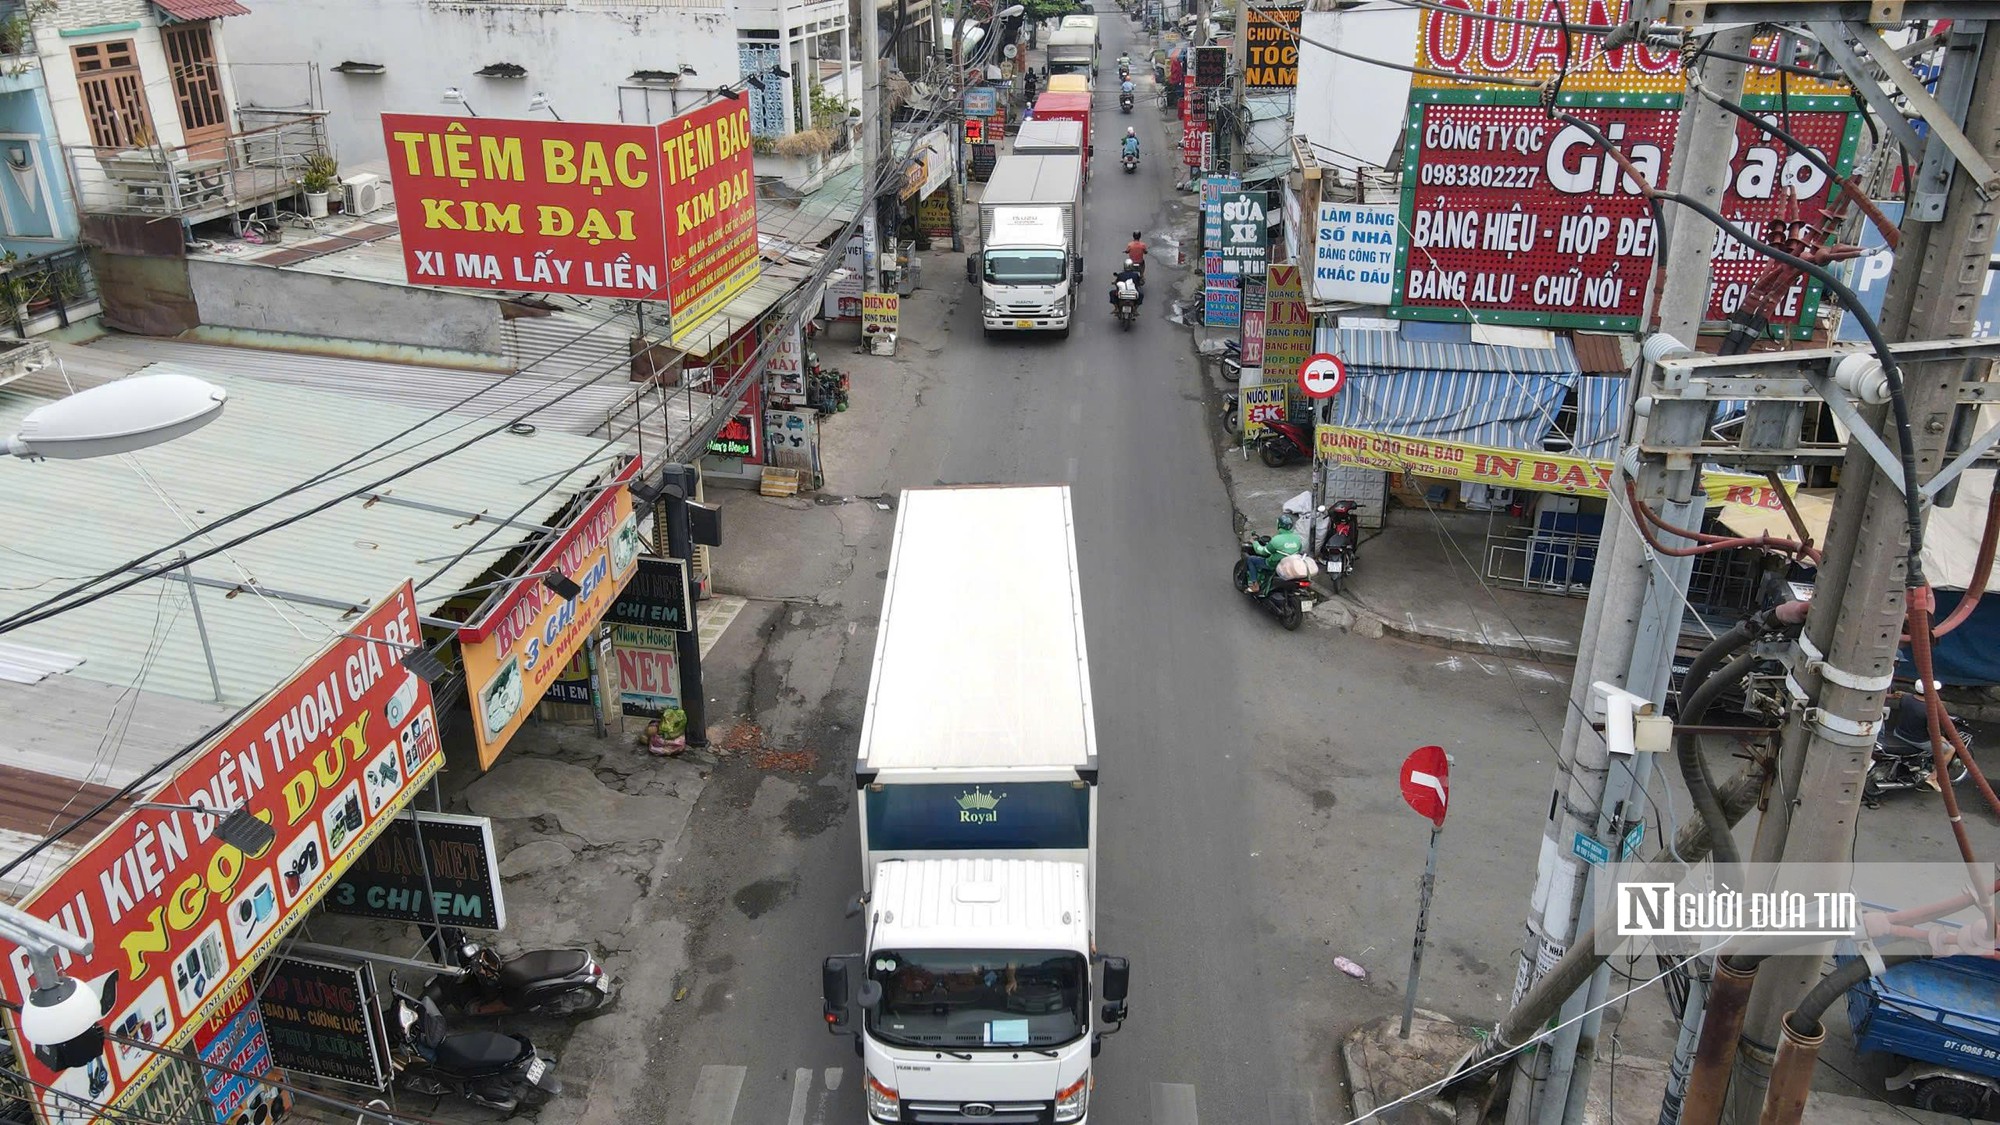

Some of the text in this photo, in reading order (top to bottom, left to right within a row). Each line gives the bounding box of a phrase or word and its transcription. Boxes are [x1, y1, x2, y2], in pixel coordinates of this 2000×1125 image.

[1250, 41, 1297, 65] TÓC
[1247, 68, 1297, 85] NAM
[663, 108, 750, 186] TIỆM BẠC
[1426, 117, 1544, 152] CÔNG TY QC
[394, 122, 648, 195] TIỆM BẠC
[1546, 121, 1663, 197] Gia
[1421, 164, 1540, 188] 0983802227
[676, 187, 715, 236] KIM
[719, 169, 749, 212] ĐẠI
[1224, 195, 1264, 221] SỬA
[421, 198, 637, 245] KIM ĐẠI
[1322, 208, 1395, 226] LÀM BẢNG
[1414, 196, 1478, 249] BẢNG
[1483, 204, 1537, 260] HIỆU
[1558, 205, 1607, 262] HỘP
[1231, 224, 1257, 242] XE
[1320, 226, 1392, 245] SỐ NHÀ
[1236, 247, 1265, 258] PHỤNG
[1319, 244, 1391, 264] BẢNG CÔNG TY
[414, 250, 445, 276] XI
[456, 254, 502, 285] MẠ
[513, 250, 573, 284] LẤY
[584, 253, 656, 290] LIỀN
[1360, 267, 1390, 284] DẤU
[1408, 261, 1467, 301] BẢNG
[1472, 273, 1513, 303] ALU
[1533, 268, 1580, 307] CHỮ
[1582, 262, 1623, 309] NỔI
[1245, 313, 1264, 339] SỬA
[1247, 344, 1260, 361] XE
[1247, 387, 1268, 404] NƯỚC
[1253, 407, 1280, 421] 5K
[1405, 443, 1429, 458] GIA
[1473, 453, 1522, 480] IN
[524, 638, 541, 672] 3
[580, 554, 607, 605] EM
[651, 605, 678, 622] EM
[646, 629, 672, 647] House
[534, 657, 555, 686] CHI
[616, 649, 674, 694] NET
[568, 685, 588, 700] EM
[100, 811, 189, 925] KIỆN
[263, 672, 343, 774] THOẠI
[345, 624, 384, 701] GIÁ
[385, 592, 412, 666] RẺ
[282, 709, 371, 826] DUY
[960, 810, 997, 825] Royal
[337, 882, 482, 919] 3 CHỊ EM
[253, 937, 272, 962] BÌNH
[273, 909, 300, 940] CHÁNH
[317, 872, 335, 893] HCM
[264, 1002, 284, 1018] BAO
[286, 1007, 301, 1022] DA
